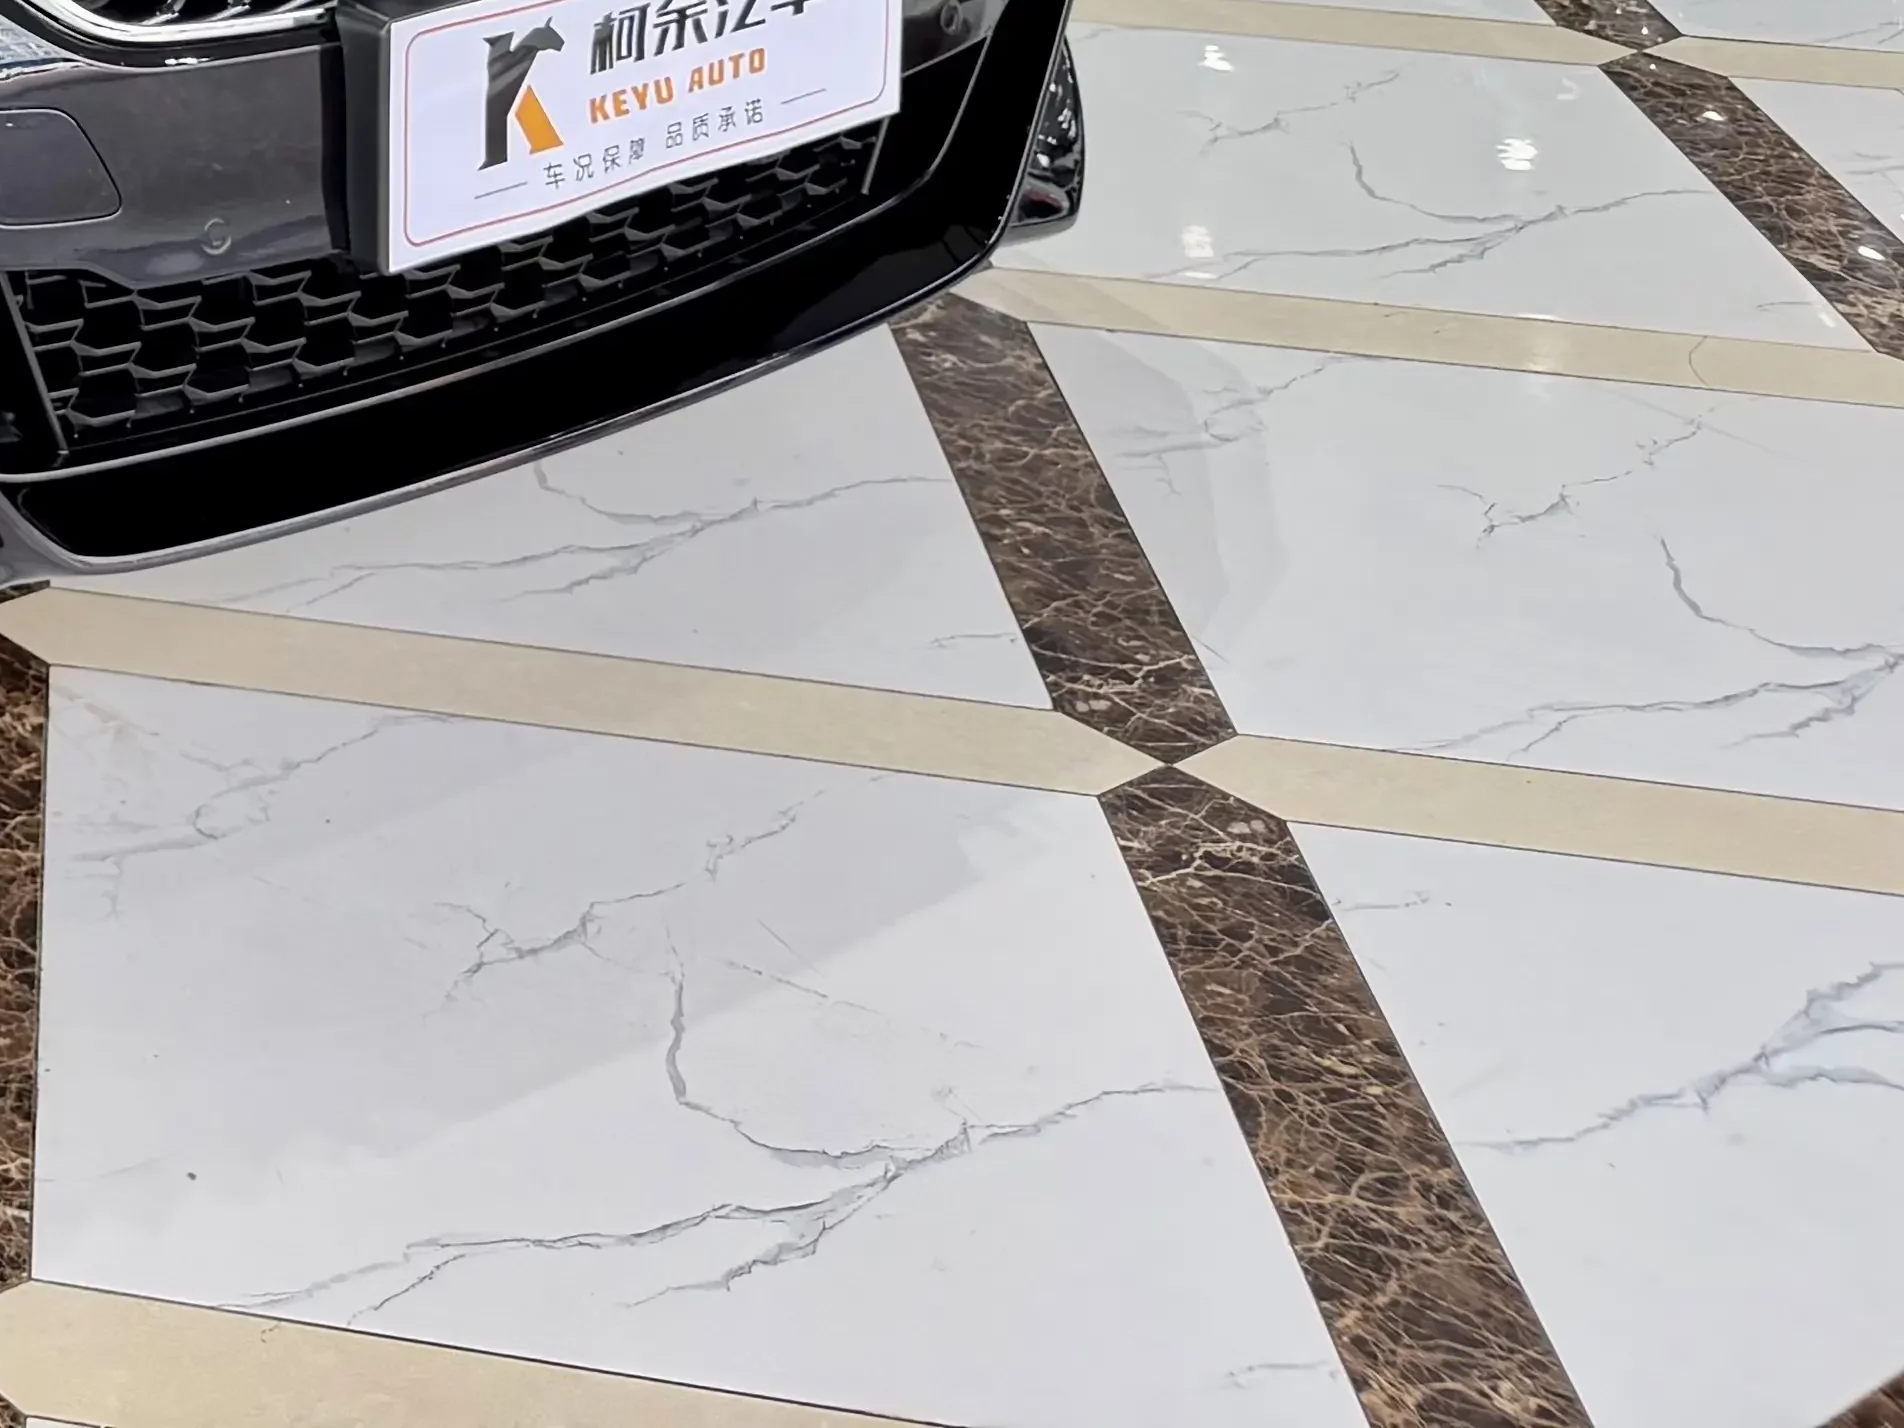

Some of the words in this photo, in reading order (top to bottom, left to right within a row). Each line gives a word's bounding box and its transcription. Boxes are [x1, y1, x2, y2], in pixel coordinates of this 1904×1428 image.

[588, 74, 674, 125] KEYU
[687, 46, 767, 95] AUTO
[542, 137, 648, 191] 车况保障
[664, 98, 765, 152] 品质承诺
